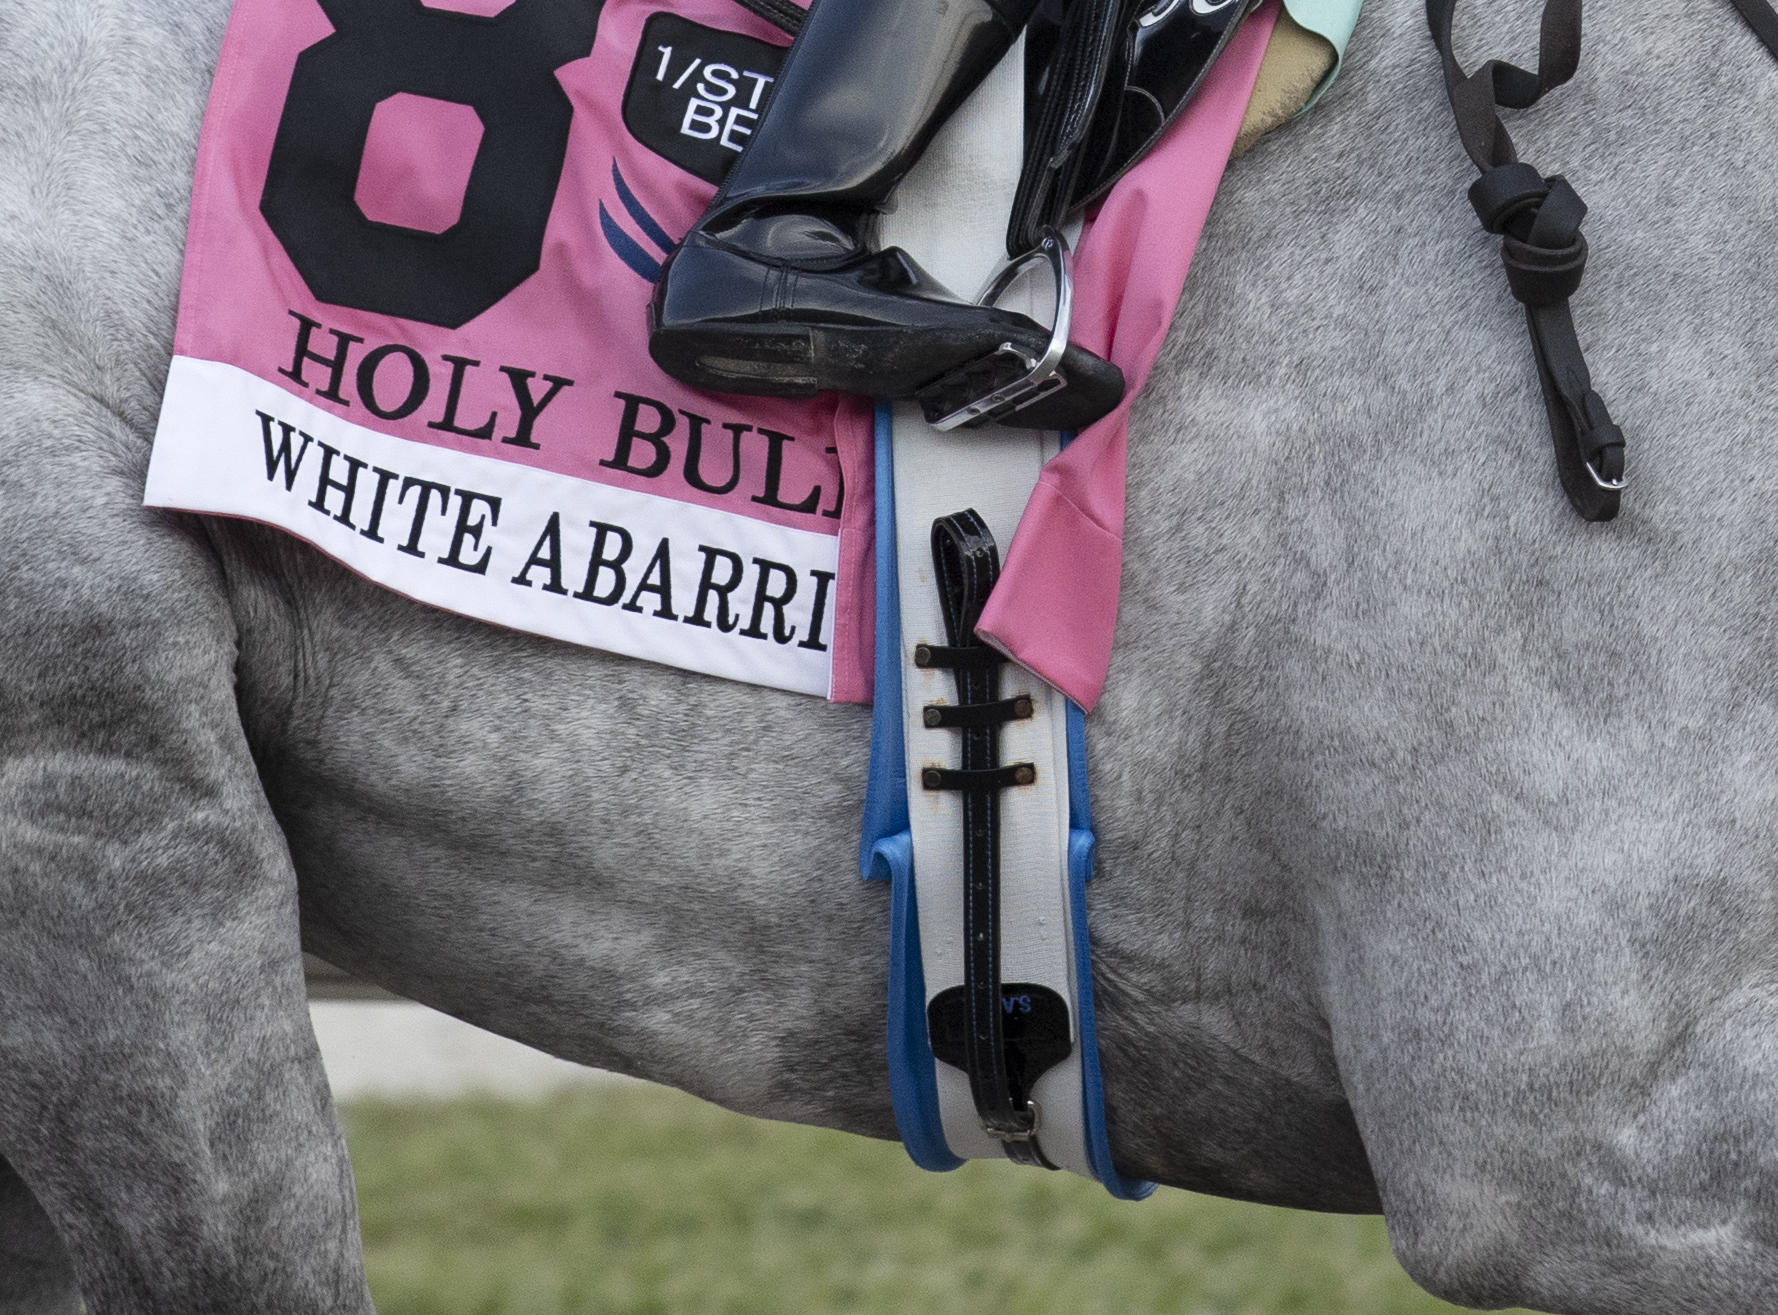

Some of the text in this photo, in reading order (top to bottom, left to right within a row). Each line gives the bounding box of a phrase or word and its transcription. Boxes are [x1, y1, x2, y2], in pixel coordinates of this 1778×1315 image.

[655, 44, 775, 110] 1/ST
[278, 309, 575, 451] HOLY
[255, 410, 503, 576] WHITE
